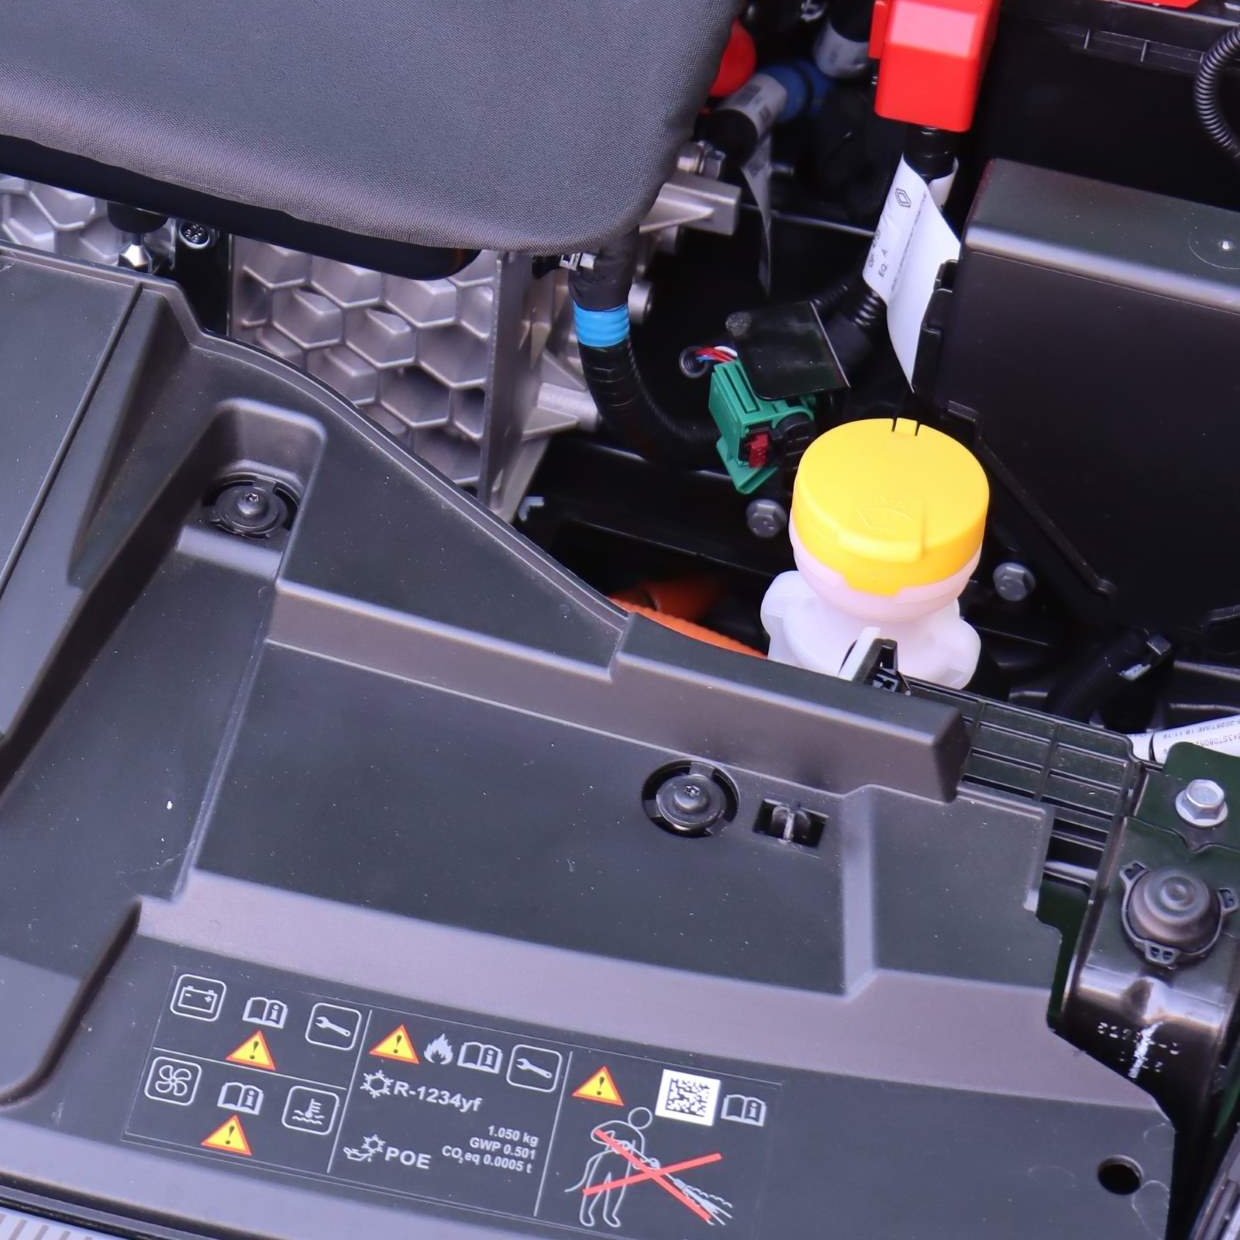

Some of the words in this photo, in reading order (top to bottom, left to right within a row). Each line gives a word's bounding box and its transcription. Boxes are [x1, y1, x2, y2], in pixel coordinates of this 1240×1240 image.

[393, 1081, 484, 1113] R-1234yf
[487, 1125, 520, 1143] 1.050
[522, 1132, 540, 1148] kg
[385, 1146, 433, 1170] POE
[469, 1137, 502, 1153] GWP
[503, 1144, 537, 1160] 0.501
[483, 1154, 524, 1172] 0.0005
[524, 1161, 533, 1174] t
